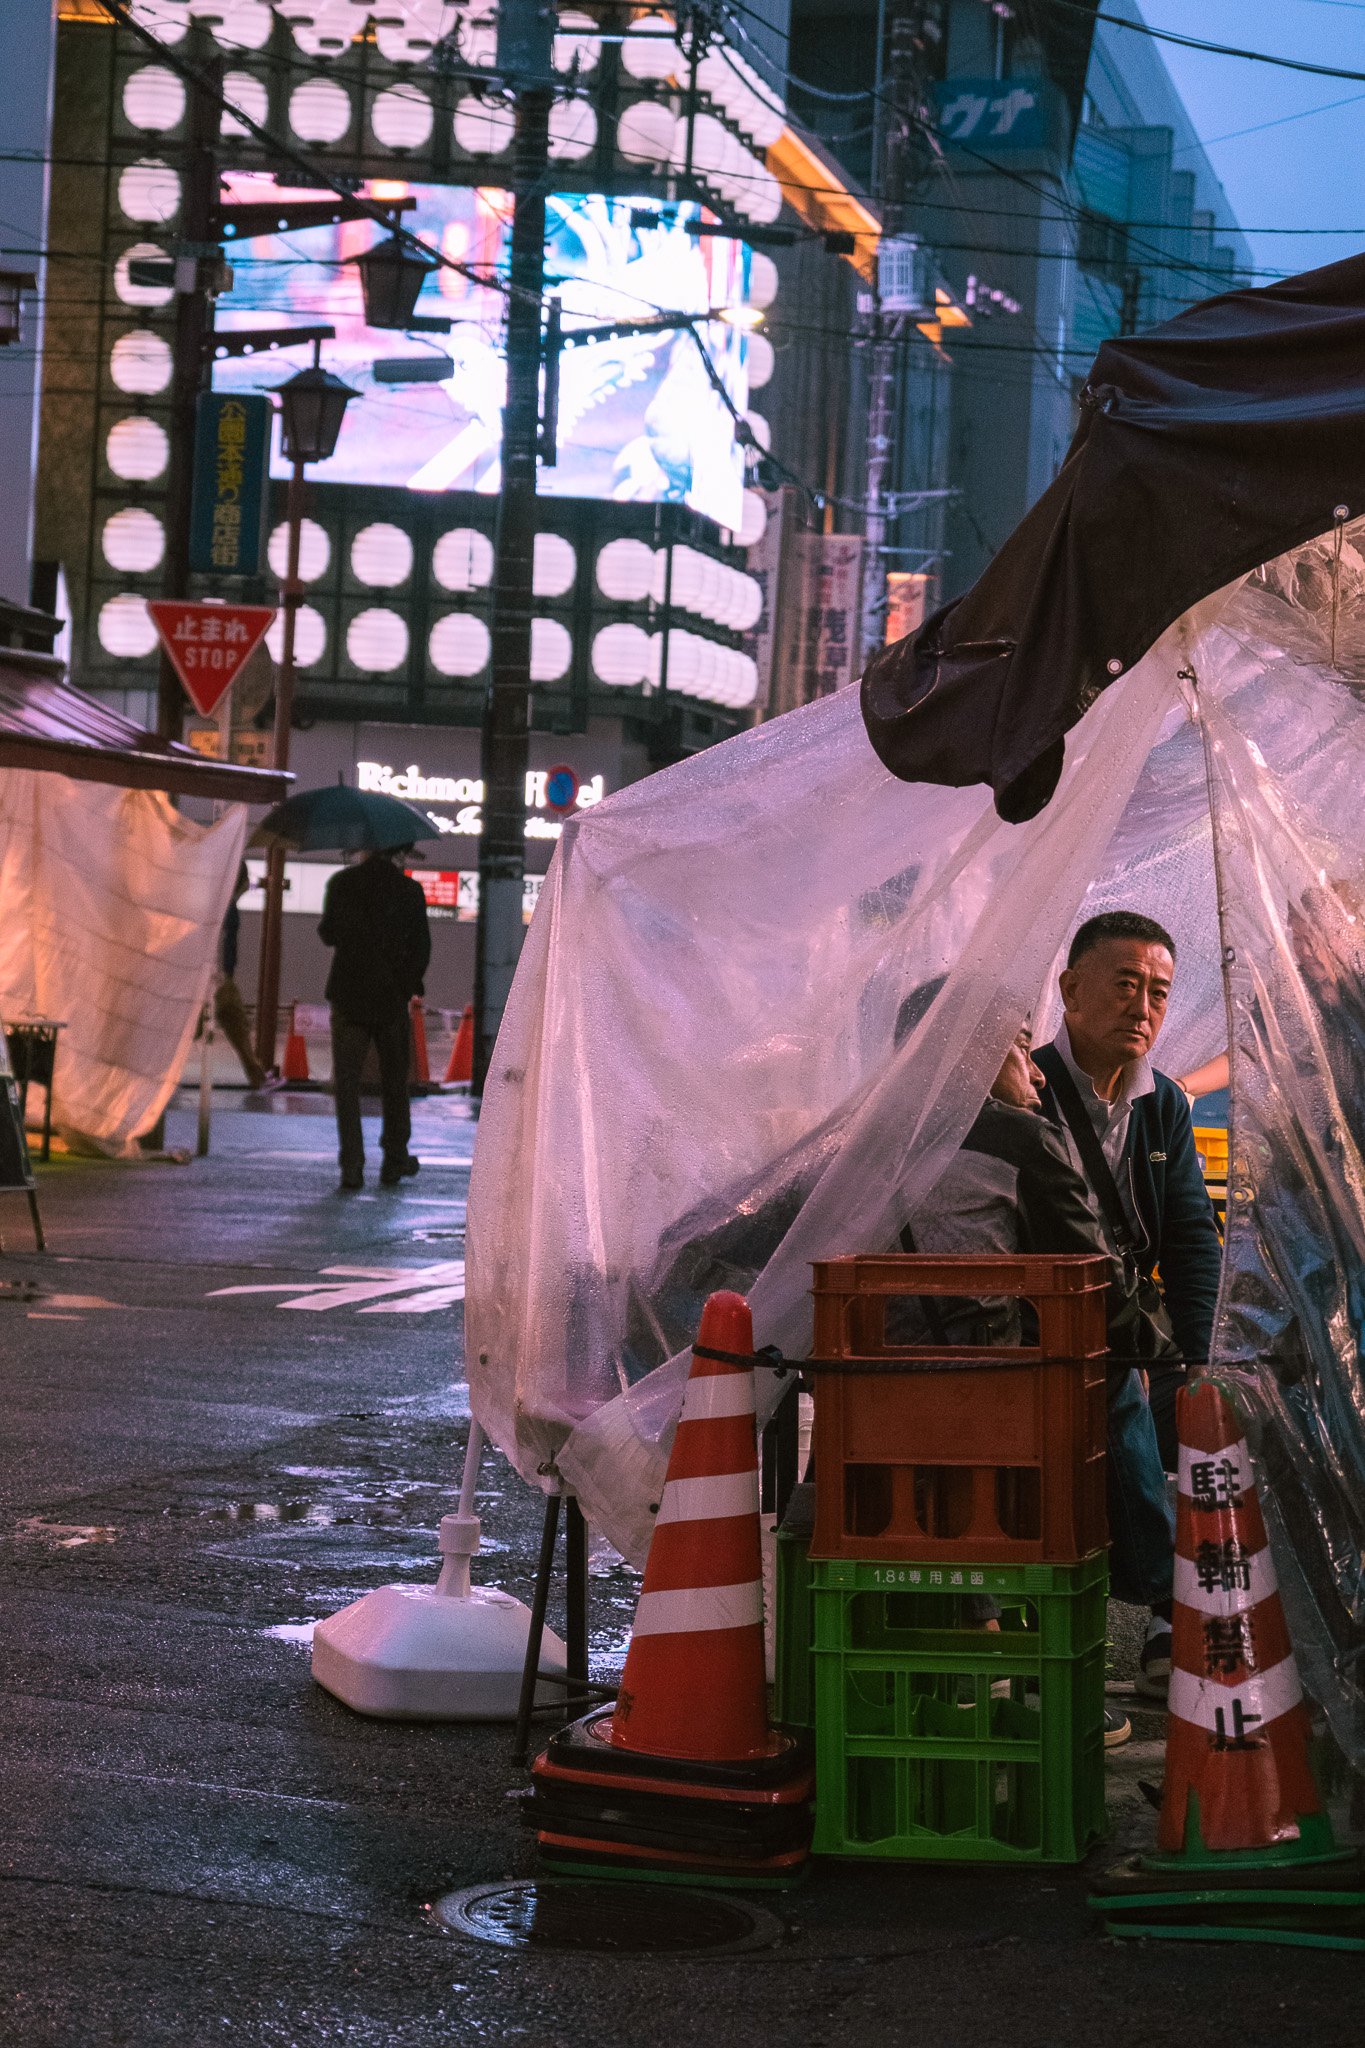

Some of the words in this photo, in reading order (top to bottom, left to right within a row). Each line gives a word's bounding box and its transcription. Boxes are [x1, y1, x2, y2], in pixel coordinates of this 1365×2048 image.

[172, 614, 249, 643] 止まれ
[185, 647, 238, 669] STOP
[357, 762, 484, 803] Richmo
[525, 770, 603, 808] Hel
